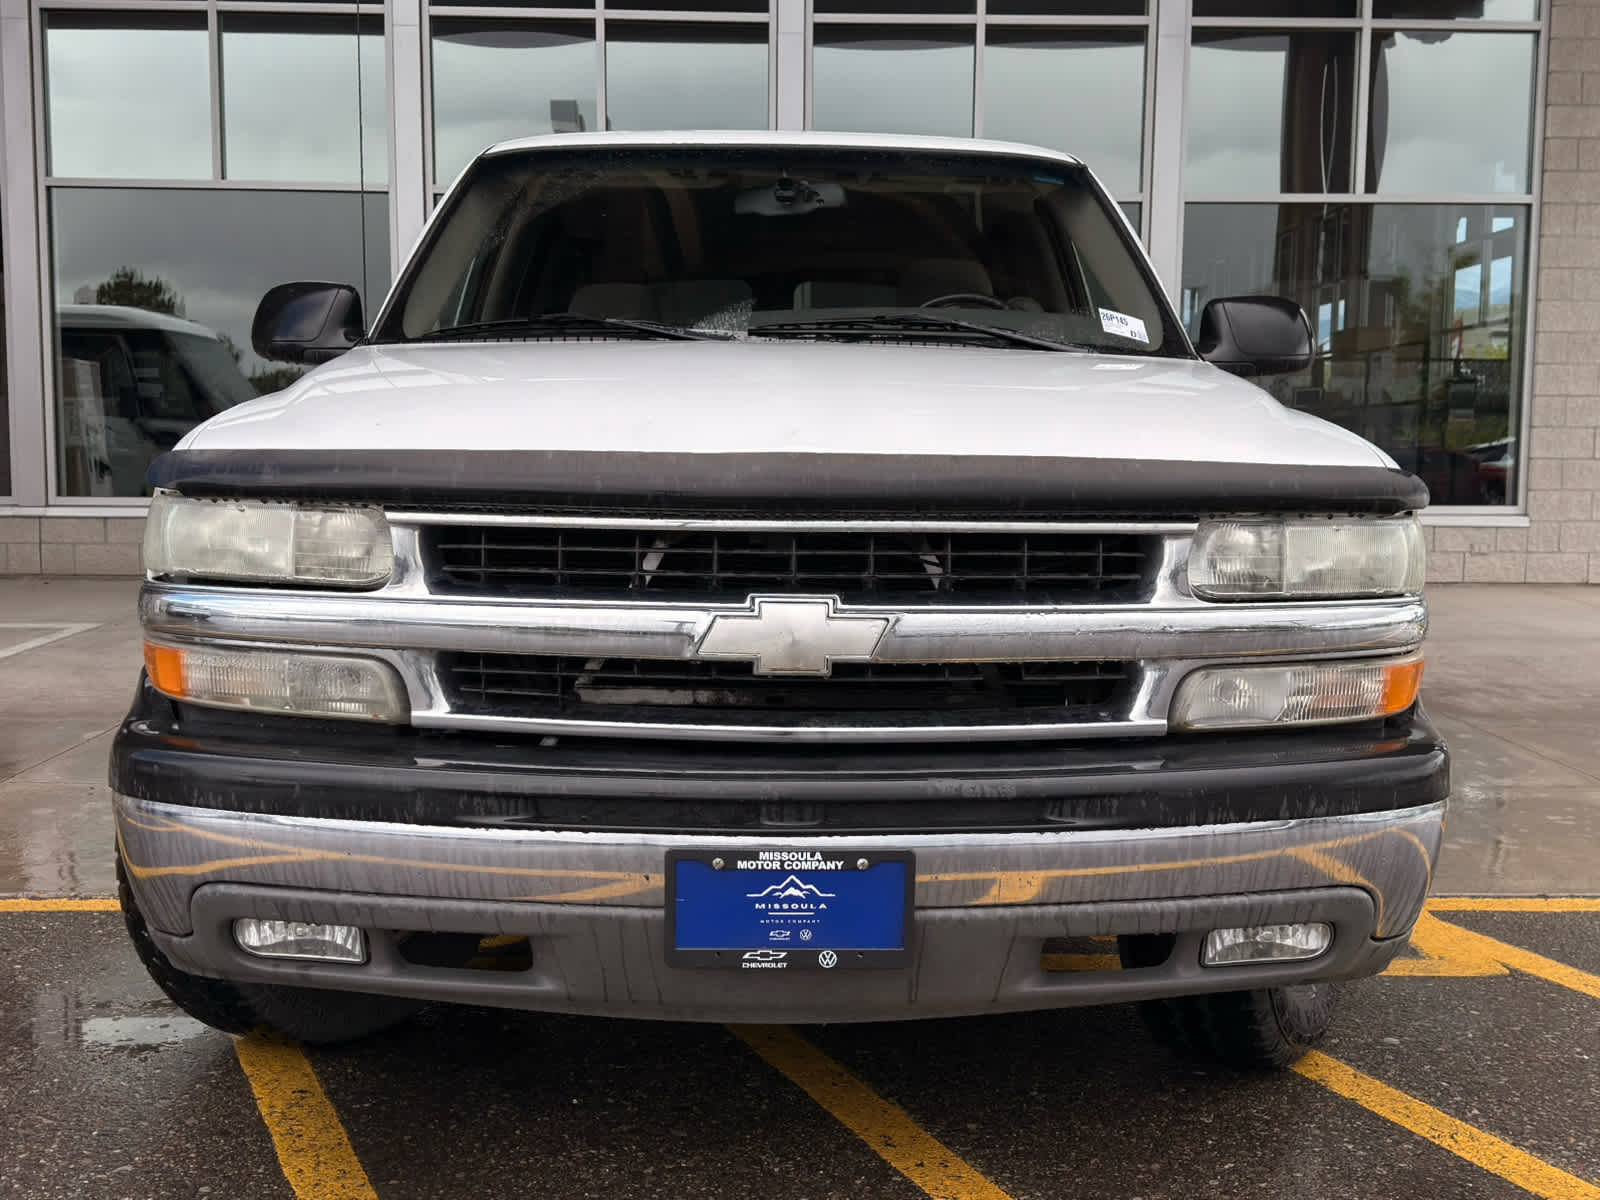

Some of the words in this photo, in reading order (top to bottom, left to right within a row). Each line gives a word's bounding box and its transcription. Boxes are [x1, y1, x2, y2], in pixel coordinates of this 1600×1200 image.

[759, 851, 822, 860] MISSOULA
[737, 860, 781, 870] MOTOR
[784, 860, 844, 870] COMPANY
